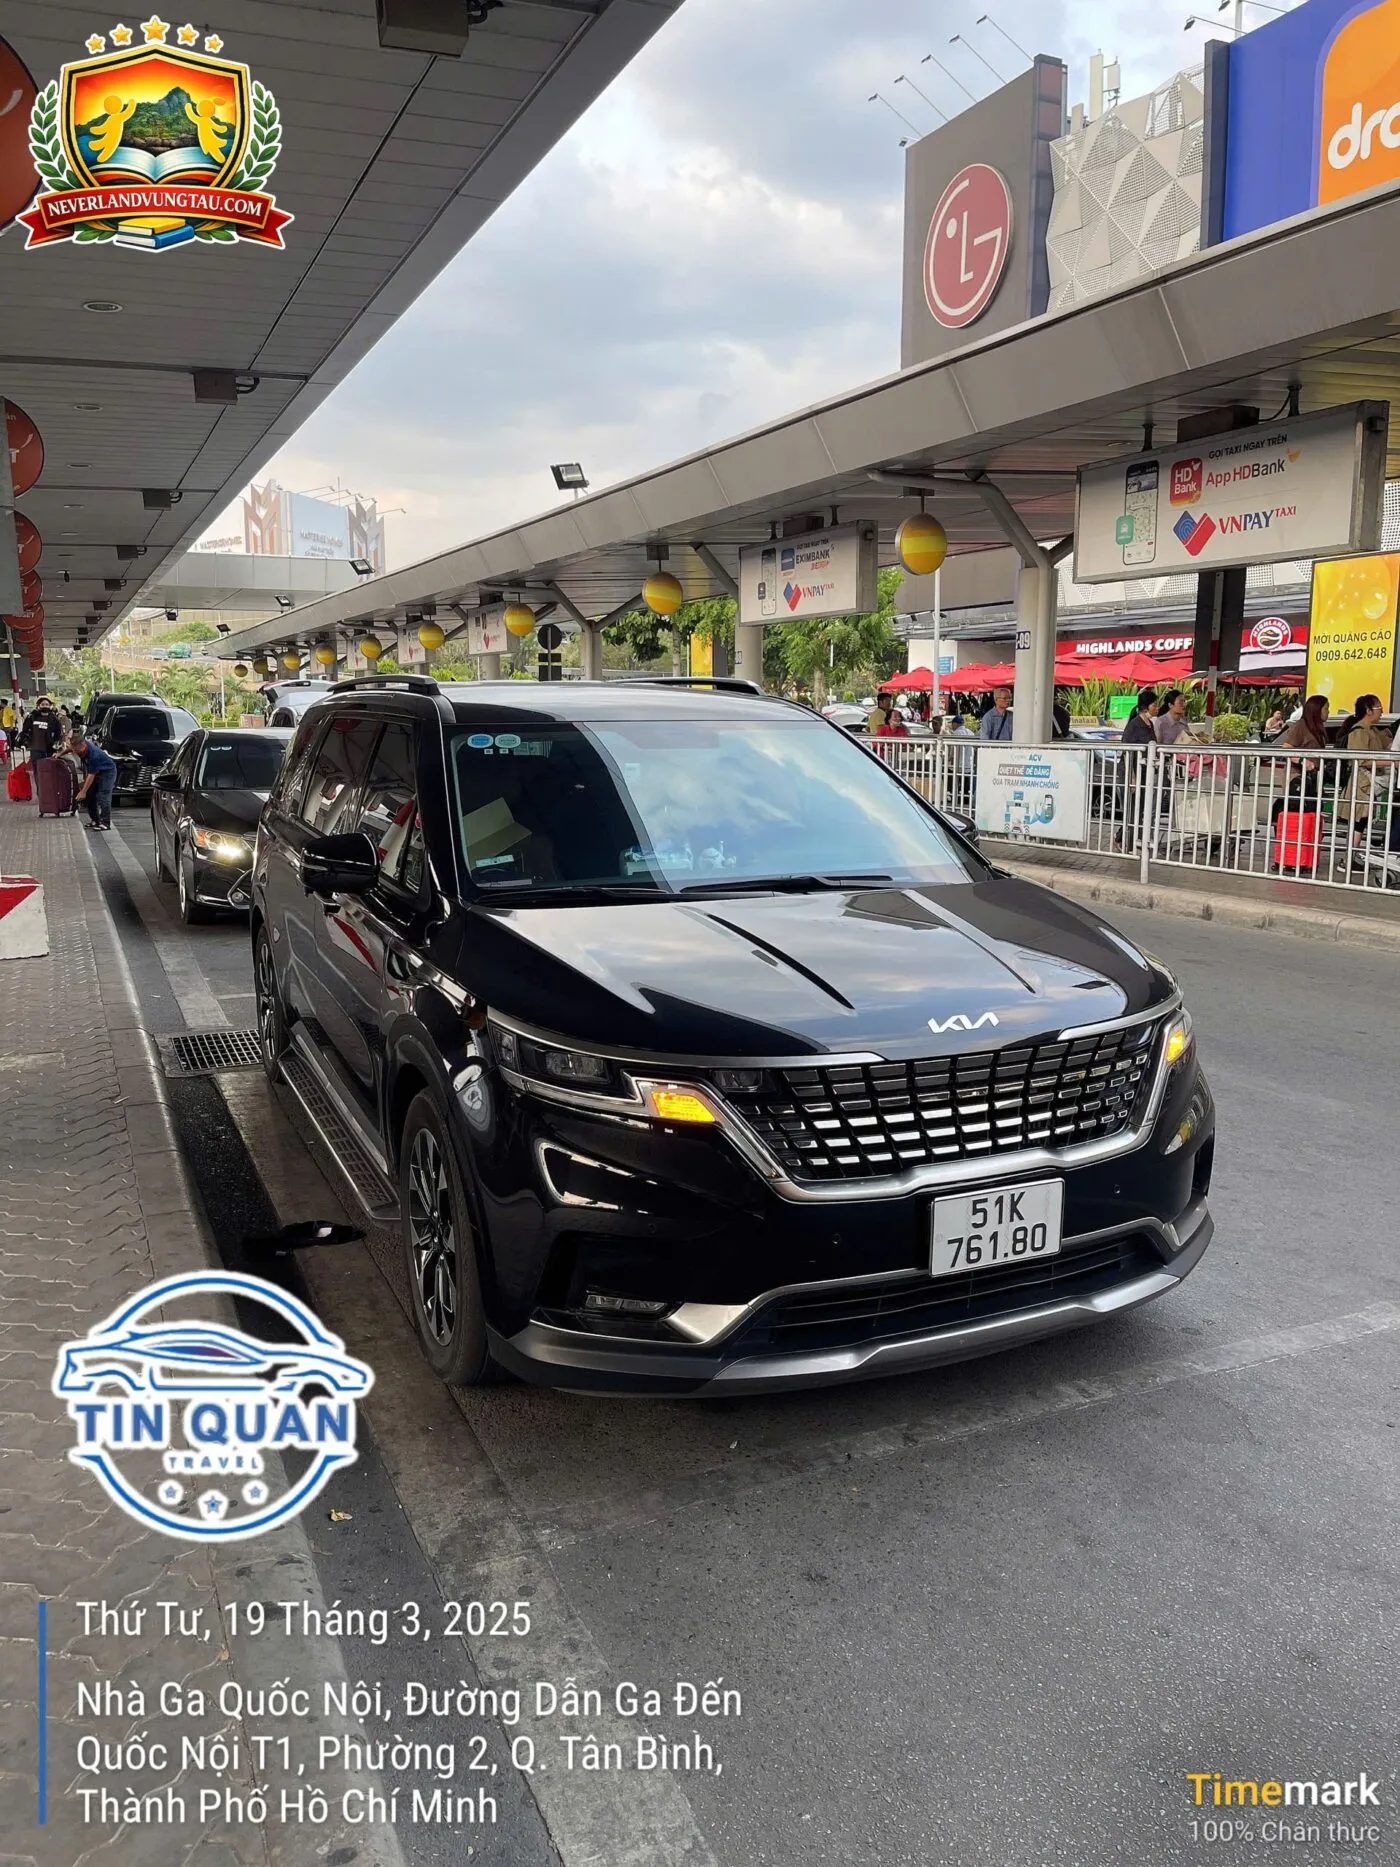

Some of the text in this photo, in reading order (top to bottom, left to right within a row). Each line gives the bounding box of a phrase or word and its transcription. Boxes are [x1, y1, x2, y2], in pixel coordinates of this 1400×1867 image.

[927, 175, 1005, 320] LG
[1208, 434, 1287, 460] GỌI TAXI NGAY TRÊN
[1175, 467, 1192, 483] HD
[1206, 459, 1286, 487] App HDBank
[1175, 481, 1197, 494] Bank
[796, 549, 830, 564] EXIMBANK
[1252, 620, 1289, 637] HIGHLANDS
[1076, 637, 1195, 654] HIGHLANDS COFF
[1313, 633, 1331, 644] MỜI
[1333, 631, 1368, 643] QUẢNG
[1316, 647, 1387, 661] 0909.642.648
[971, 1191, 1026, 1228] 51K
[947, 1222, 1047, 1268] 761.80
